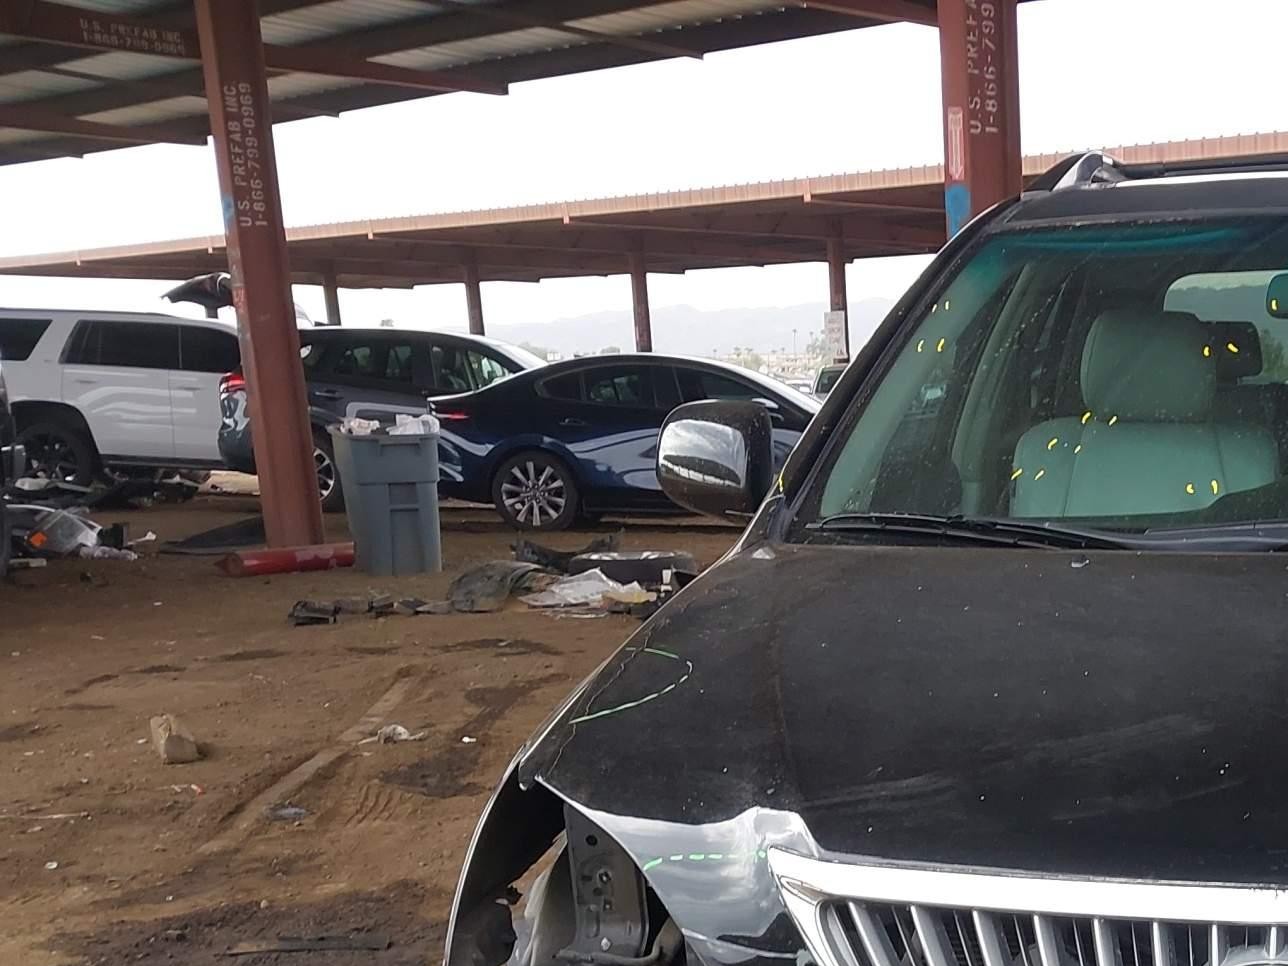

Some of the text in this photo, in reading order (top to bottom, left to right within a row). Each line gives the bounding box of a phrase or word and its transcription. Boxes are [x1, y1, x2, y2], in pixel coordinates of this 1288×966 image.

[969, 88, 982, 134] U.S.
[228, 121, 247, 186] PREFAB
[238, 82, 267, 226] 1-866-799-0969
[238, 195, 252, 226] U.S.
